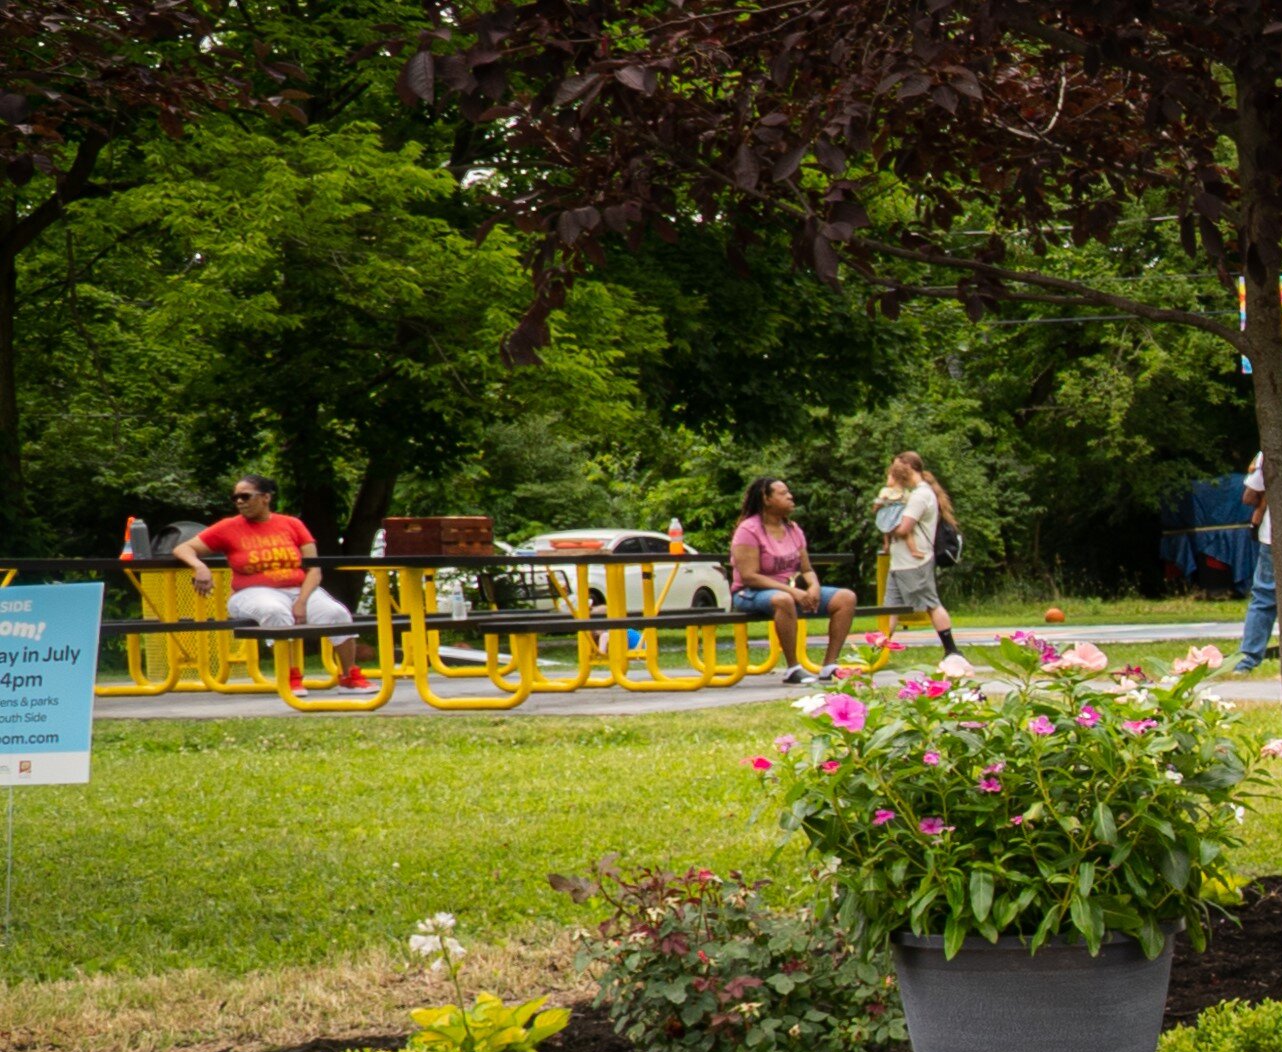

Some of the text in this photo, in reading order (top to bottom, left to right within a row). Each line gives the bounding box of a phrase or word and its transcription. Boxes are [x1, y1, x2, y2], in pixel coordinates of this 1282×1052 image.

[248, 547, 298, 564] SOME
[22, 646, 39, 663] in
[42, 645, 81, 665] July
[20, 697, 28, 707] &
[30, 696, 59, 709] parks
[25, 712, 47, 722] Side
